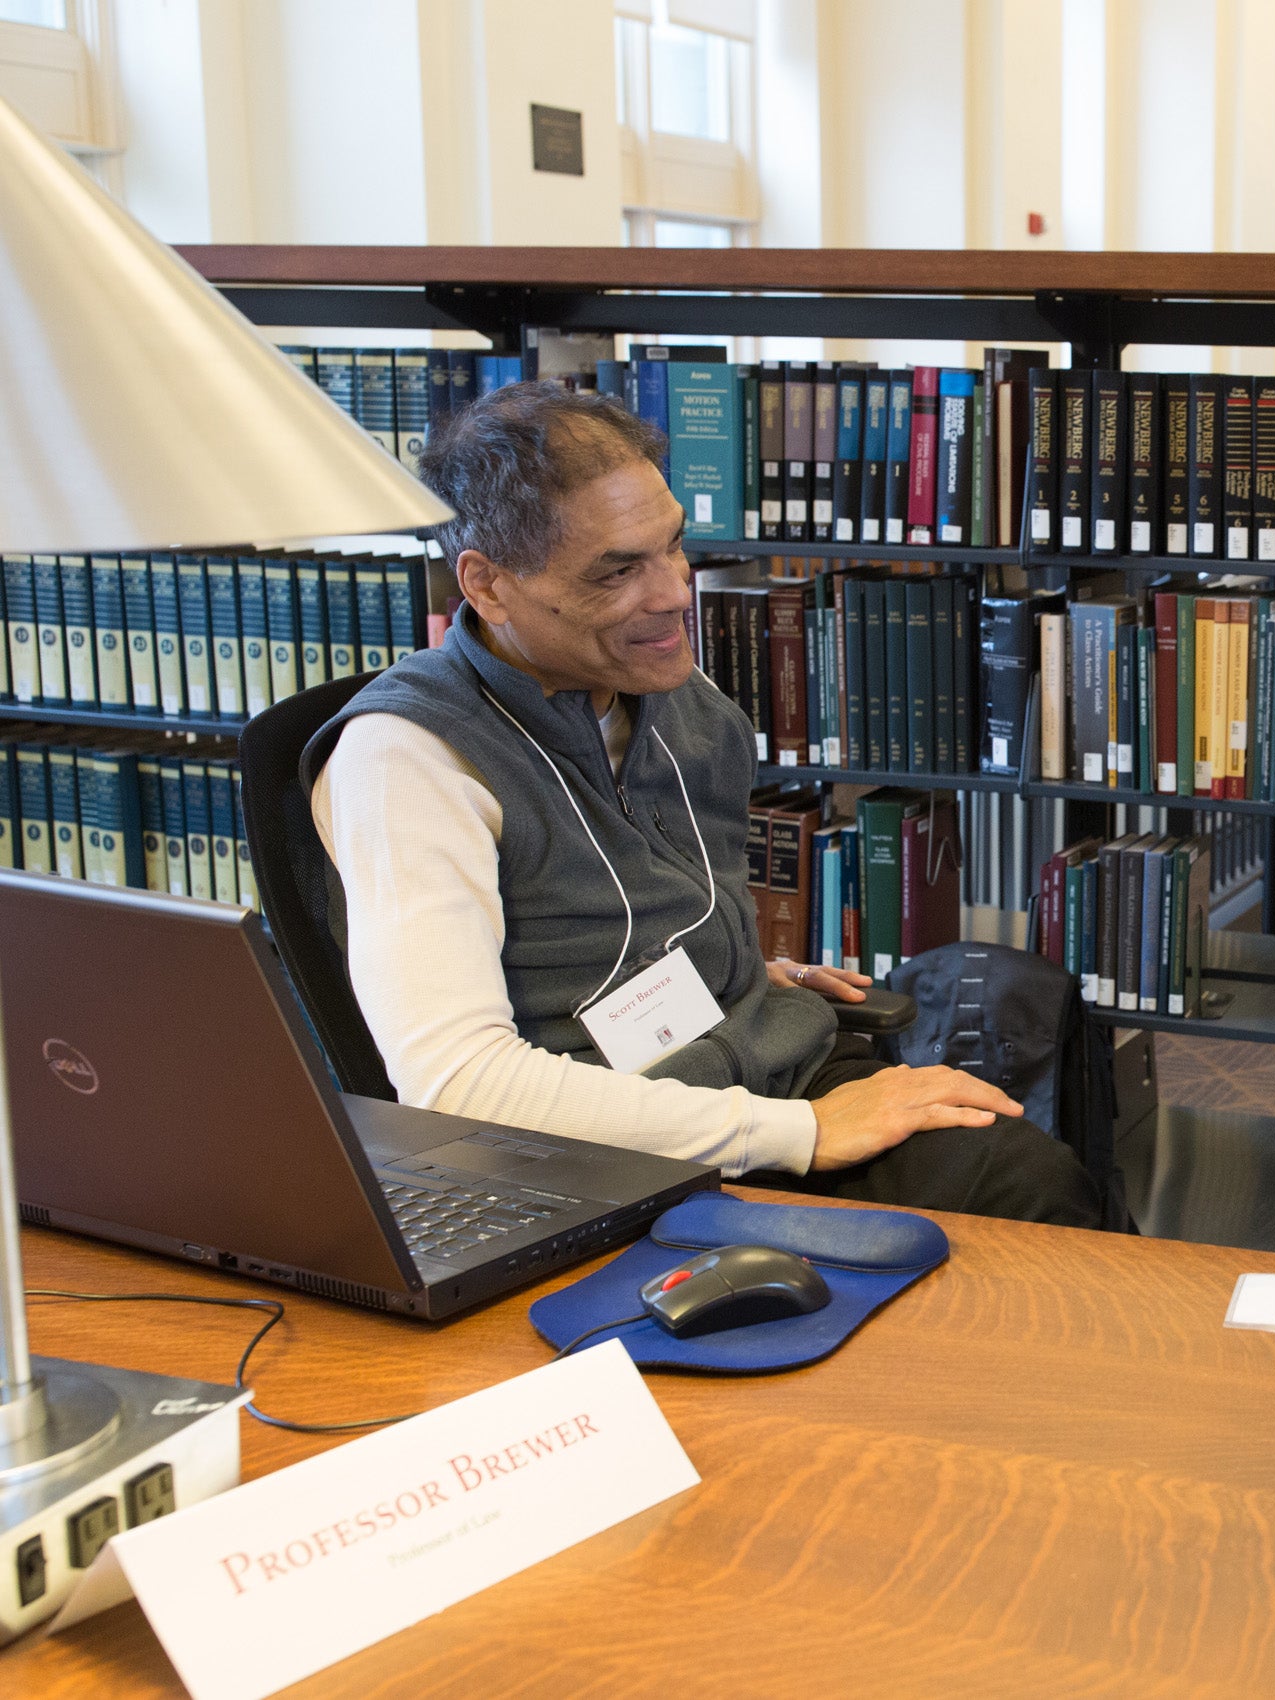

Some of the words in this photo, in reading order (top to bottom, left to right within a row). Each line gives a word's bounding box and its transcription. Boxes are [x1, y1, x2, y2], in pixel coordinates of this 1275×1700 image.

[683, 396, 719, 404] MOTION
[681, 408, 722, 417] PRACTICE
[1040, 397, 1050, 459] NEWBERG
[1072, 397, 1082, 459] NEWBERG
[1105, 400, 1116, 461] NEWBERG
[1140, 400, 1151, 462] NEWBERG
[1175, 401, 1186, 462] NEWBERG
[1202, 401, 1214, 463] NEWBERG
[950, 432, 957, 442] OF
[948, 444, 957, 493] LIMITATIONS
[1038, 490, 1044, 500] 1
[1070, 490, 1078, 501] 2
[1103, 493, 1110, 503] 3
[1137, 494, 1145, 504] 4
[1174, 494, 1181, 504] 5
[1200, 495, 1208, 505] 6
[1235, 519, 1241, 527] 6
[1265, 520, 1272, 529] 7
[706, 622, 714, 637] Law
[1085, 619, 1092, 629] to
[751, 639, 758, 648] of
[1085, 631, 1093, 654] Class
[751, 649, 759, 667] Class
[1095, 629, 1103, 686] Practitioner's
[1095, 687, 1103, 715] Guide
[773, 830, 792, 839] CLASS
[773, 839, 798, 849] ACTIONS
[1125, 947, 1133, 992] LITIGATION
[608, 1000, 636, 1022] SCOTT
[636, 976, 672, 1003] BREWER
[220, 1480, 449, 1596] PROFESSOR
[447, 1412, 601, 1492] BREWER
